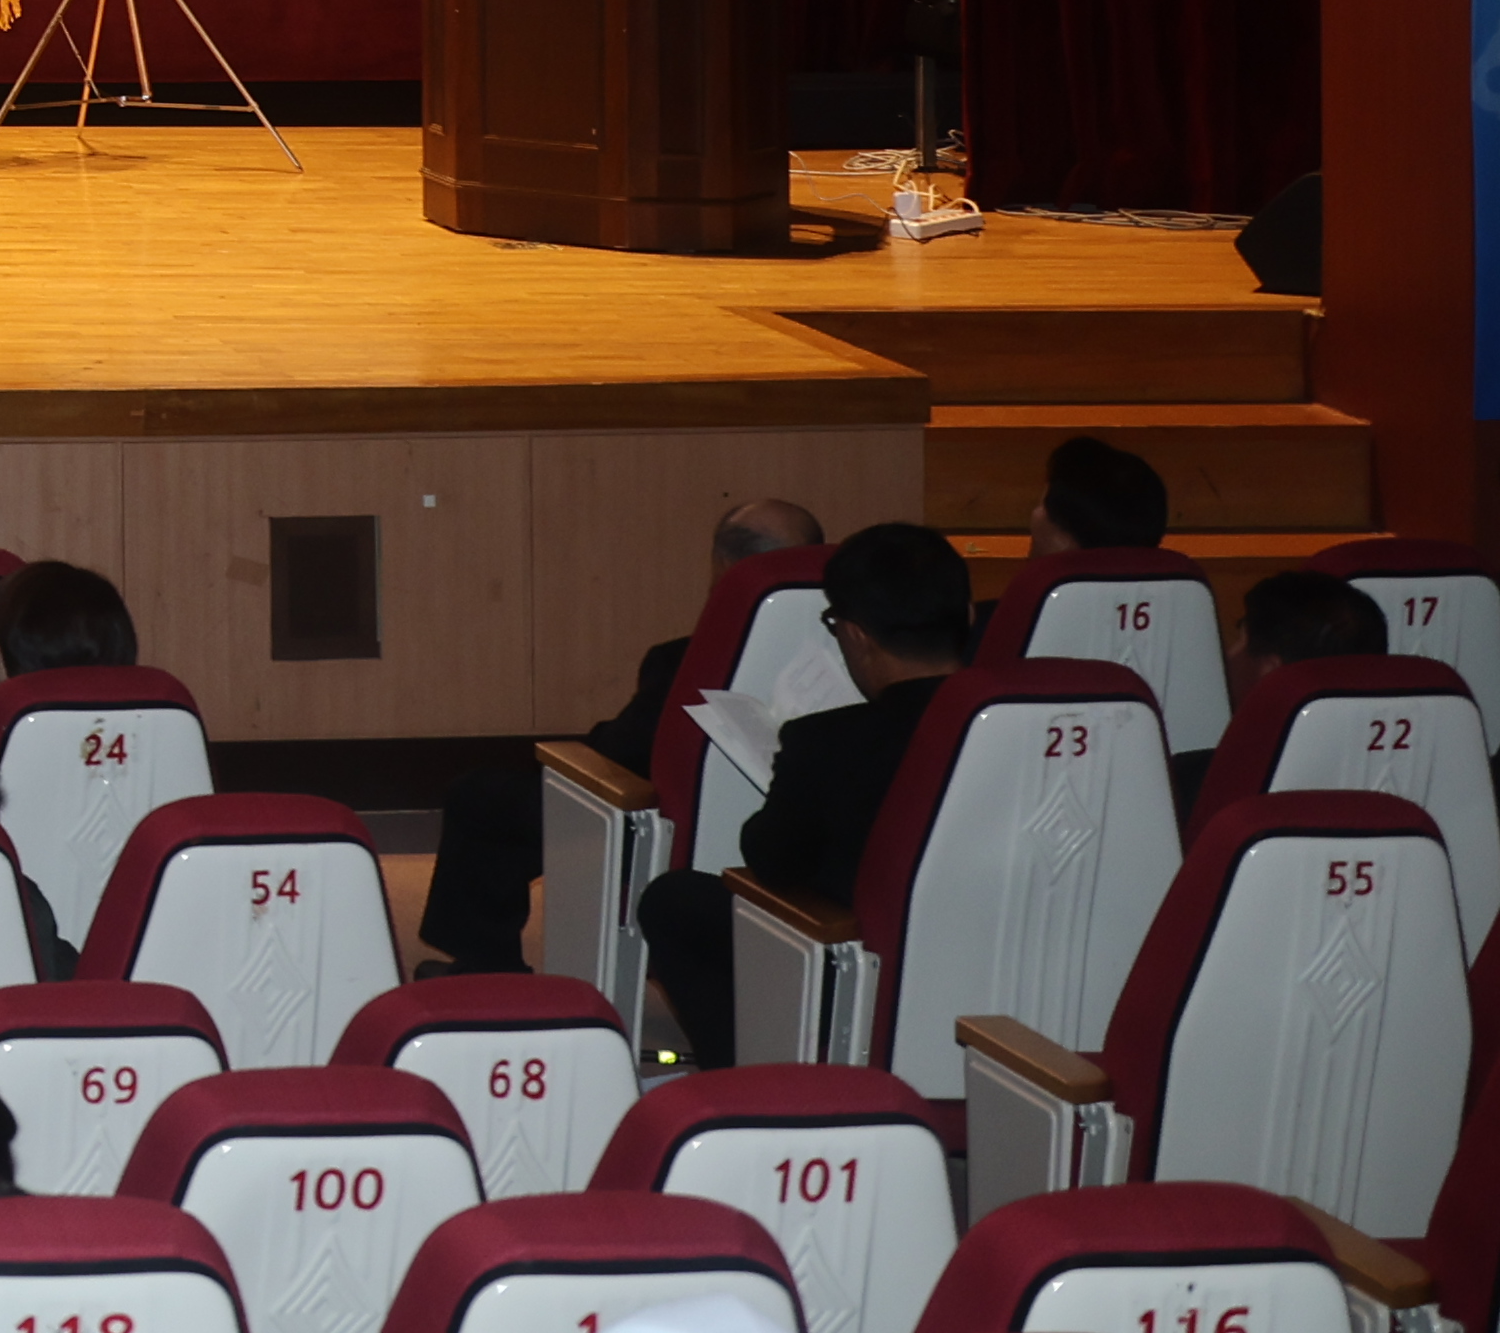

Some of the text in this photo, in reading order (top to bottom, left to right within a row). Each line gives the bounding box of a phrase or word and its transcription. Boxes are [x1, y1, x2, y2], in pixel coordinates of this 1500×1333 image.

[1118, 603, 1150, 631] 16
[1405, 597, 1439, 625] 17
[86, 735, 126, 765] 24
[1045, 726, 1089, 757] 23
[1368, 719, 1412, 751] 22
[253, 870, 300, 906] 54
[1329, 861, 1374, 896] 55
[83, 1067, 138, 1104] 69
[491, 1059, 546, 1100] 68
[292, 1168, 384, 1210] 100
[777, 1158, 857, 1202] 101
